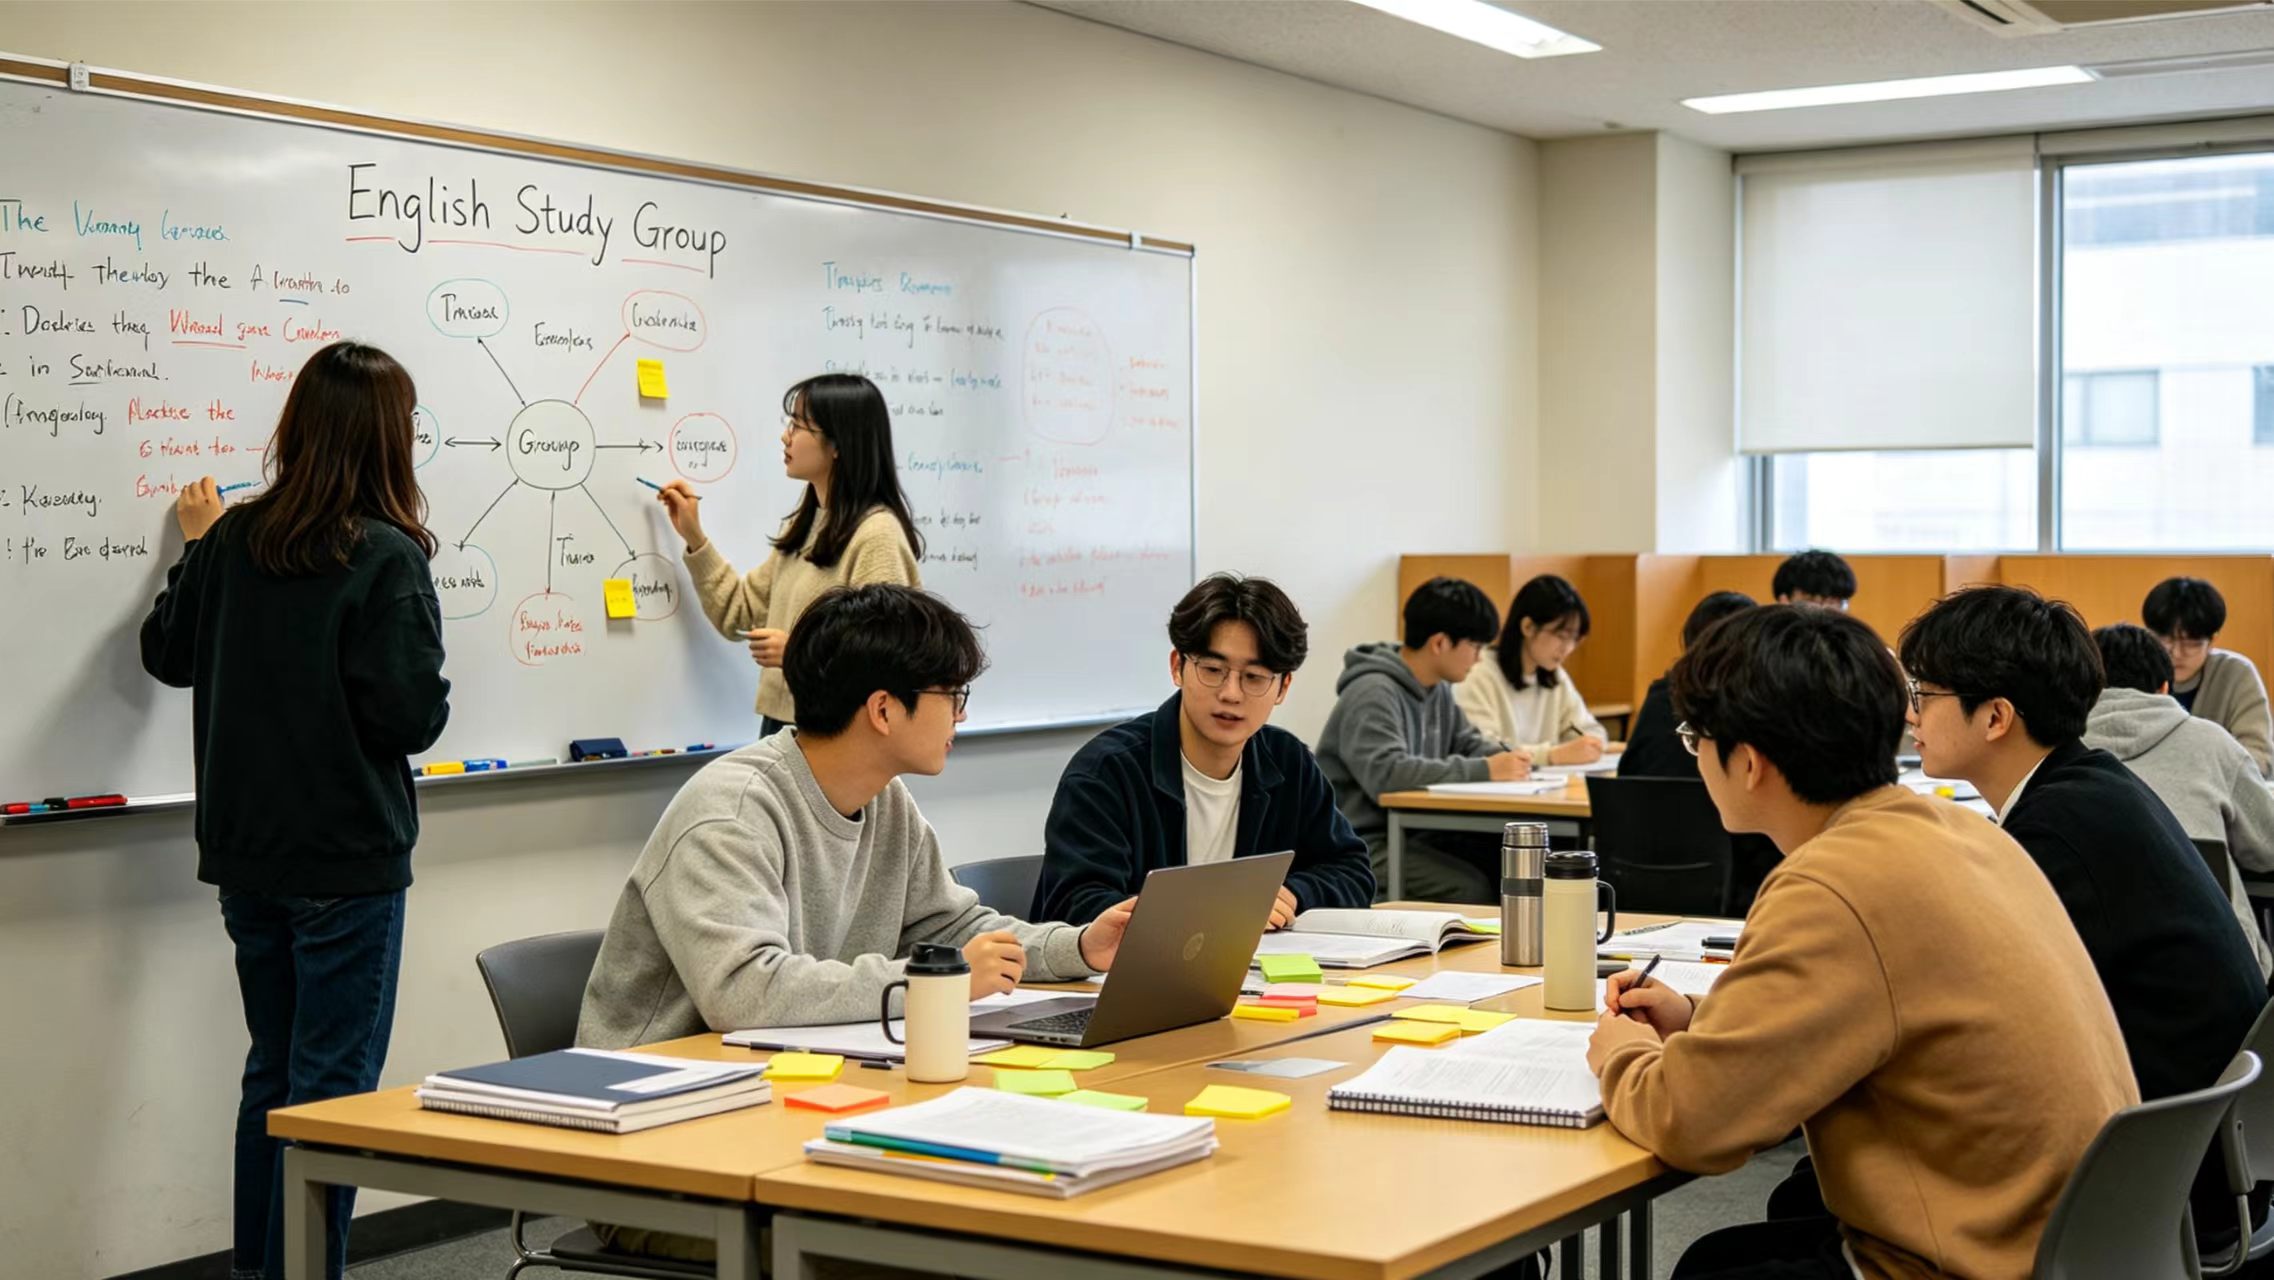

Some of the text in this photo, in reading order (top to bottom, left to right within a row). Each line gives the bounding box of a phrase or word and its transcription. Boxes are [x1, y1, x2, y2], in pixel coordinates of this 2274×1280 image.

[0, 198, 49, 232] The
[348, 163, 491, 254] English
[515, 185, 614, 266] Study
[633, 202, 727, 279] Group
[188, 261, 232, 288] the
[29, 355, 51, 377] in
[207, 398, 236, 421] the
